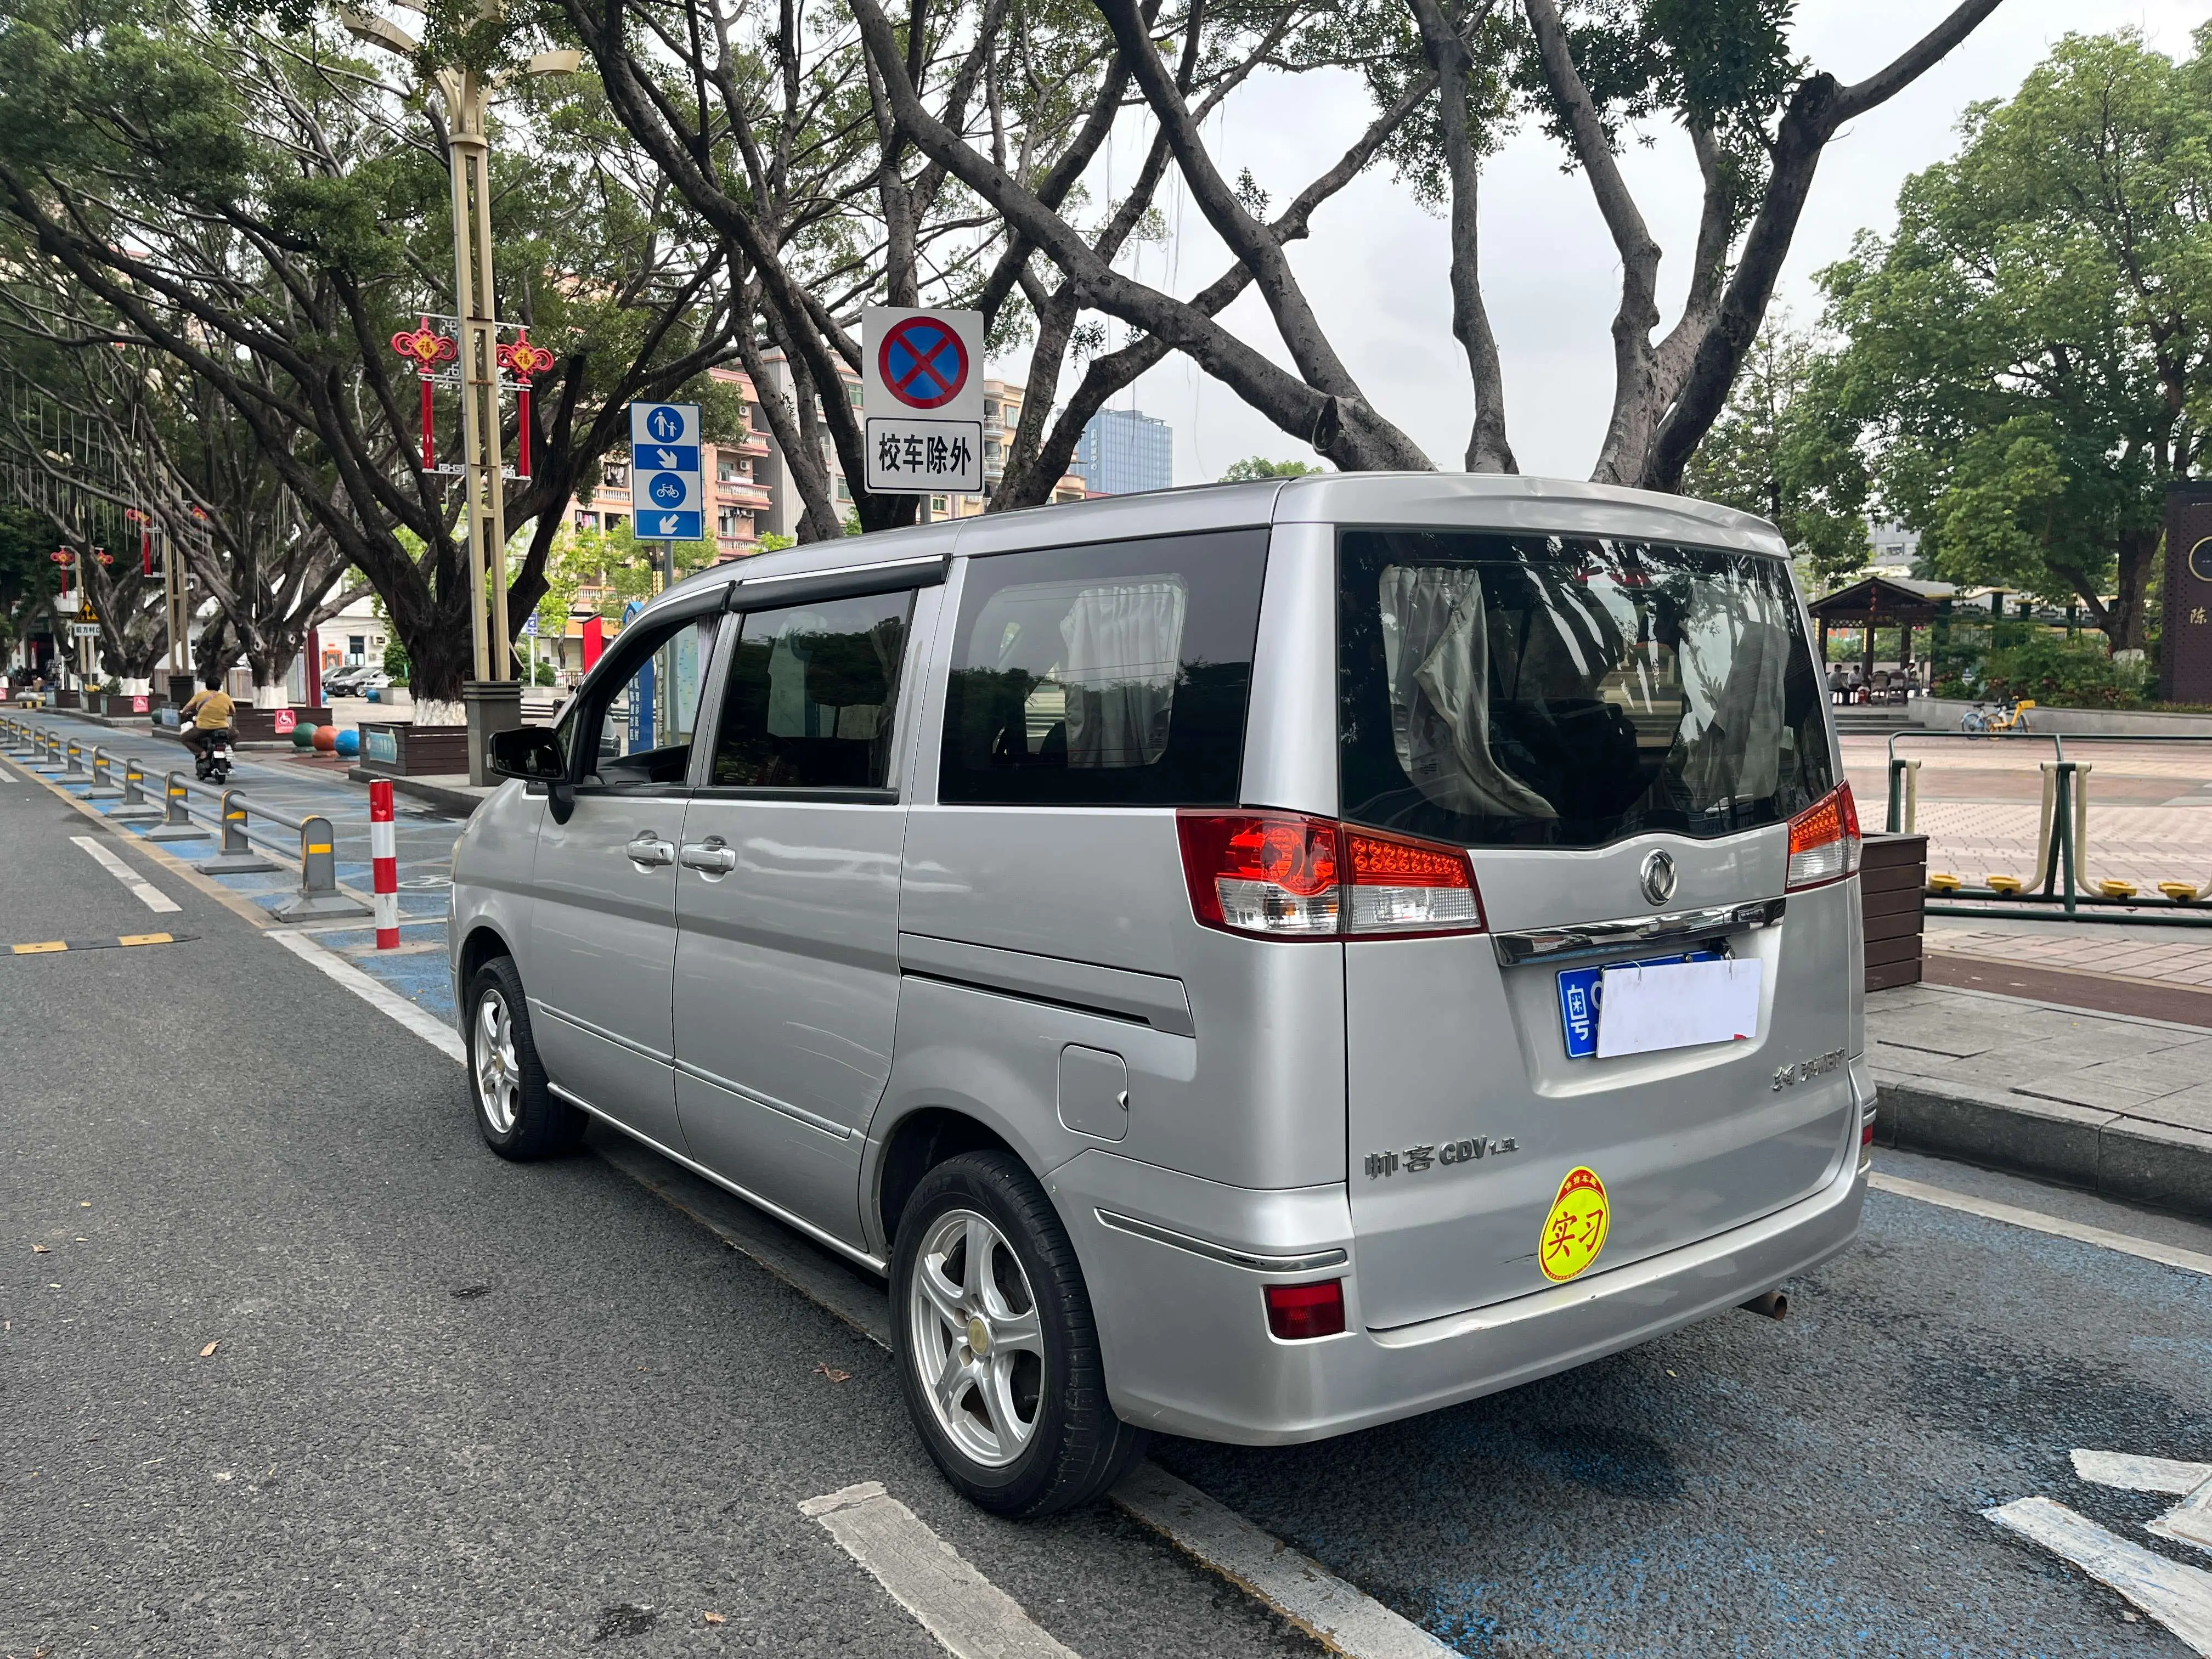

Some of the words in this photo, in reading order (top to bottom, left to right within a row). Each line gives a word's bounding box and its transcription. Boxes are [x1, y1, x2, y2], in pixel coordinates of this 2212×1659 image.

[419, 341, 432, 354] 福
[517, 353, 530, 365] 福
[879, 432, 972, 476] 校车除外
[1364, 1144, 1436, 1180] 帅客
[1439, 1134, 1487, 1165] CDV
[1546, 1208, 1604, 1261] 实习
